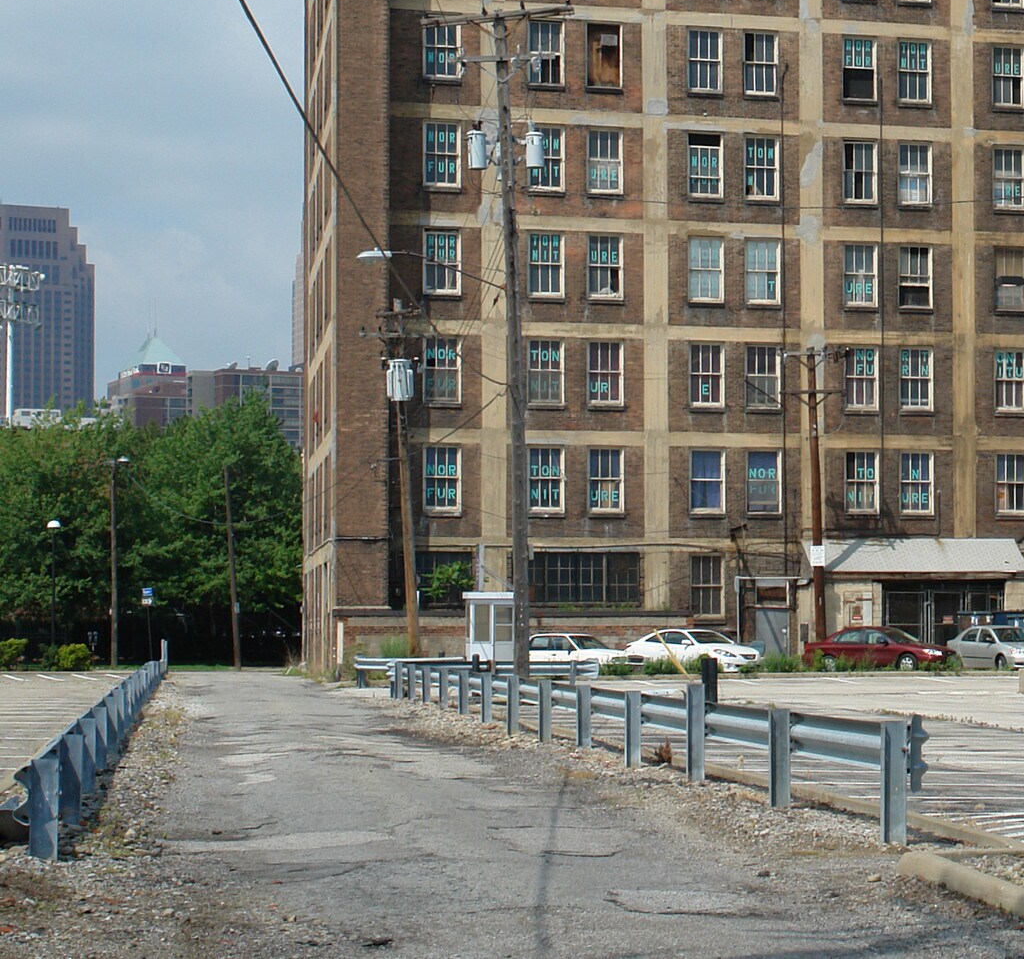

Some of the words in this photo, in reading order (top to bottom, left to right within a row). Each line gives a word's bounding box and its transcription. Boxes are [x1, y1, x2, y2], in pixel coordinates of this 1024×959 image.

[845, 40, 870, 52] NOR
[900, 42, 927, 56] TON
[845, 54, 871, 68] FUR
[900, 56, 927, 71] NIT
[995, 62, 1019, 74] URE
[427, 130, 455, 143] NOR
[691, 155, 717, 168] NOR
[748, 146, 773, 160] TON
[428, 161, 455, 174] FUR
[590, 169, 617, 182] URE
[532, 235, 559, 248] TON
[531, 249, 560, 262] NIT
[591, 250, 618, 262] URE
[845, 281, 872, 295] URE
[426, 348, 455, 359] NOR
[530, 349, 559, 362] TON
[426, 464, 456, 475] NOR
[531, 465, 559, 476] TON
[748, 468, 777, 480] NOR
[426, 487, 456, 499] FUR
[530, 488, 559, 500] NIT
[589, 490, 618, 502] URE
[902, 493, 929, 504] URE
